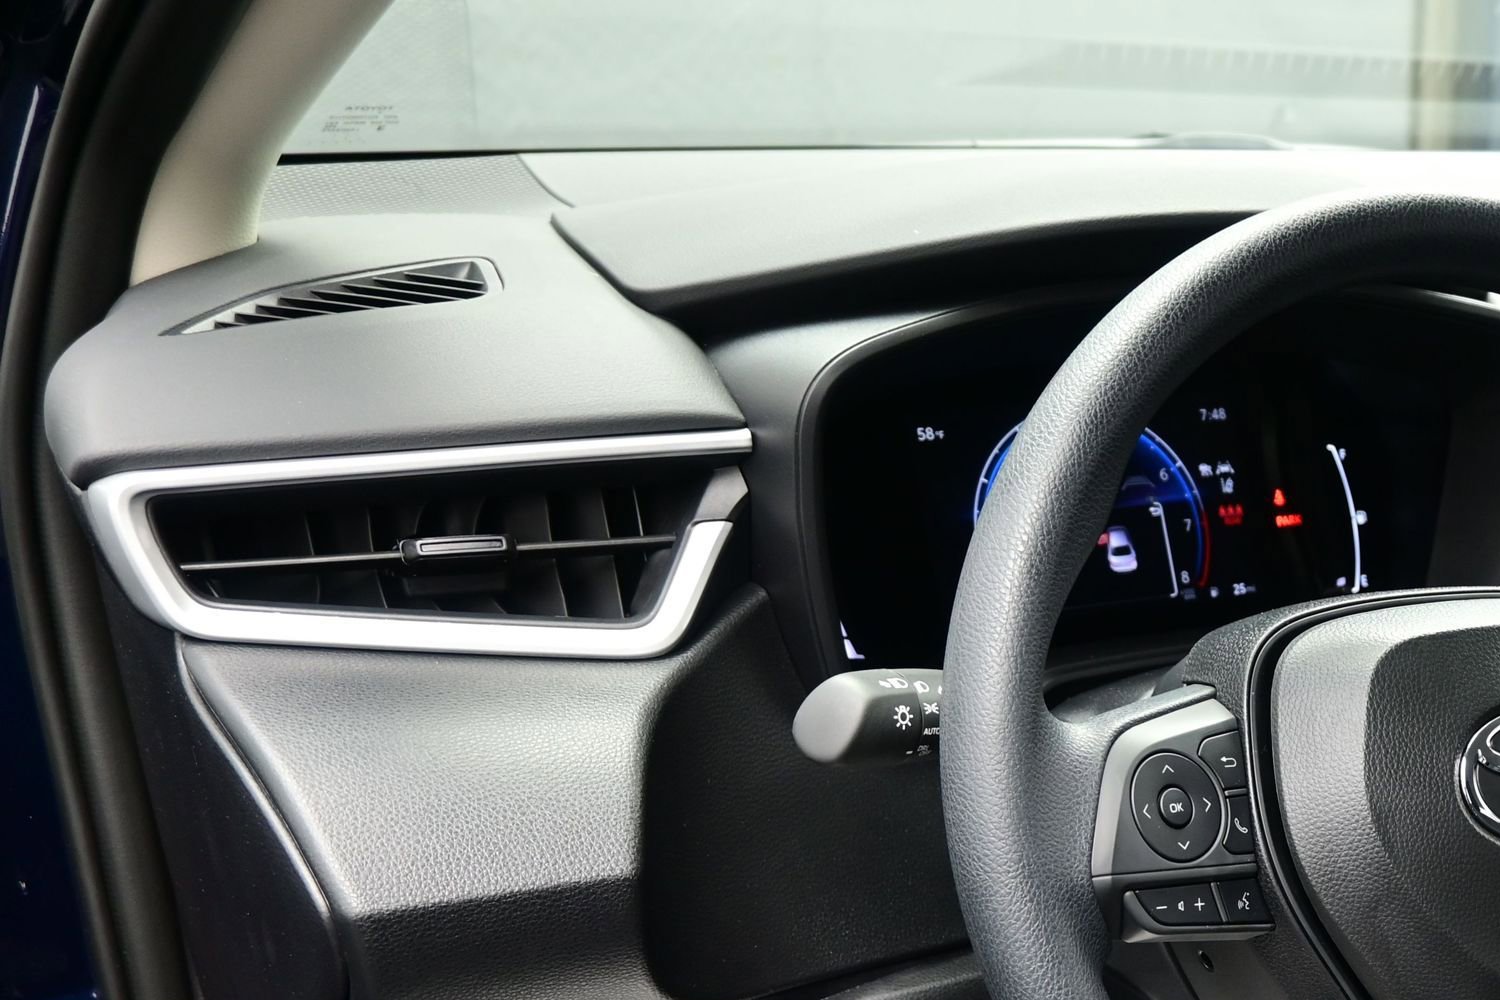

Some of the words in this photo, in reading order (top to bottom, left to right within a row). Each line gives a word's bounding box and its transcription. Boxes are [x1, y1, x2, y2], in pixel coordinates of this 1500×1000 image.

[1199, 407, 1227, 421] 7:48
[1159, 468, 1169, 481] 6
[1184, 518, 1192, 532] 7
[1275, 514, 1303, 528] PARK
[1181, 570, 1190, 584] 8
[1169, 802, 1185, 813] OK
